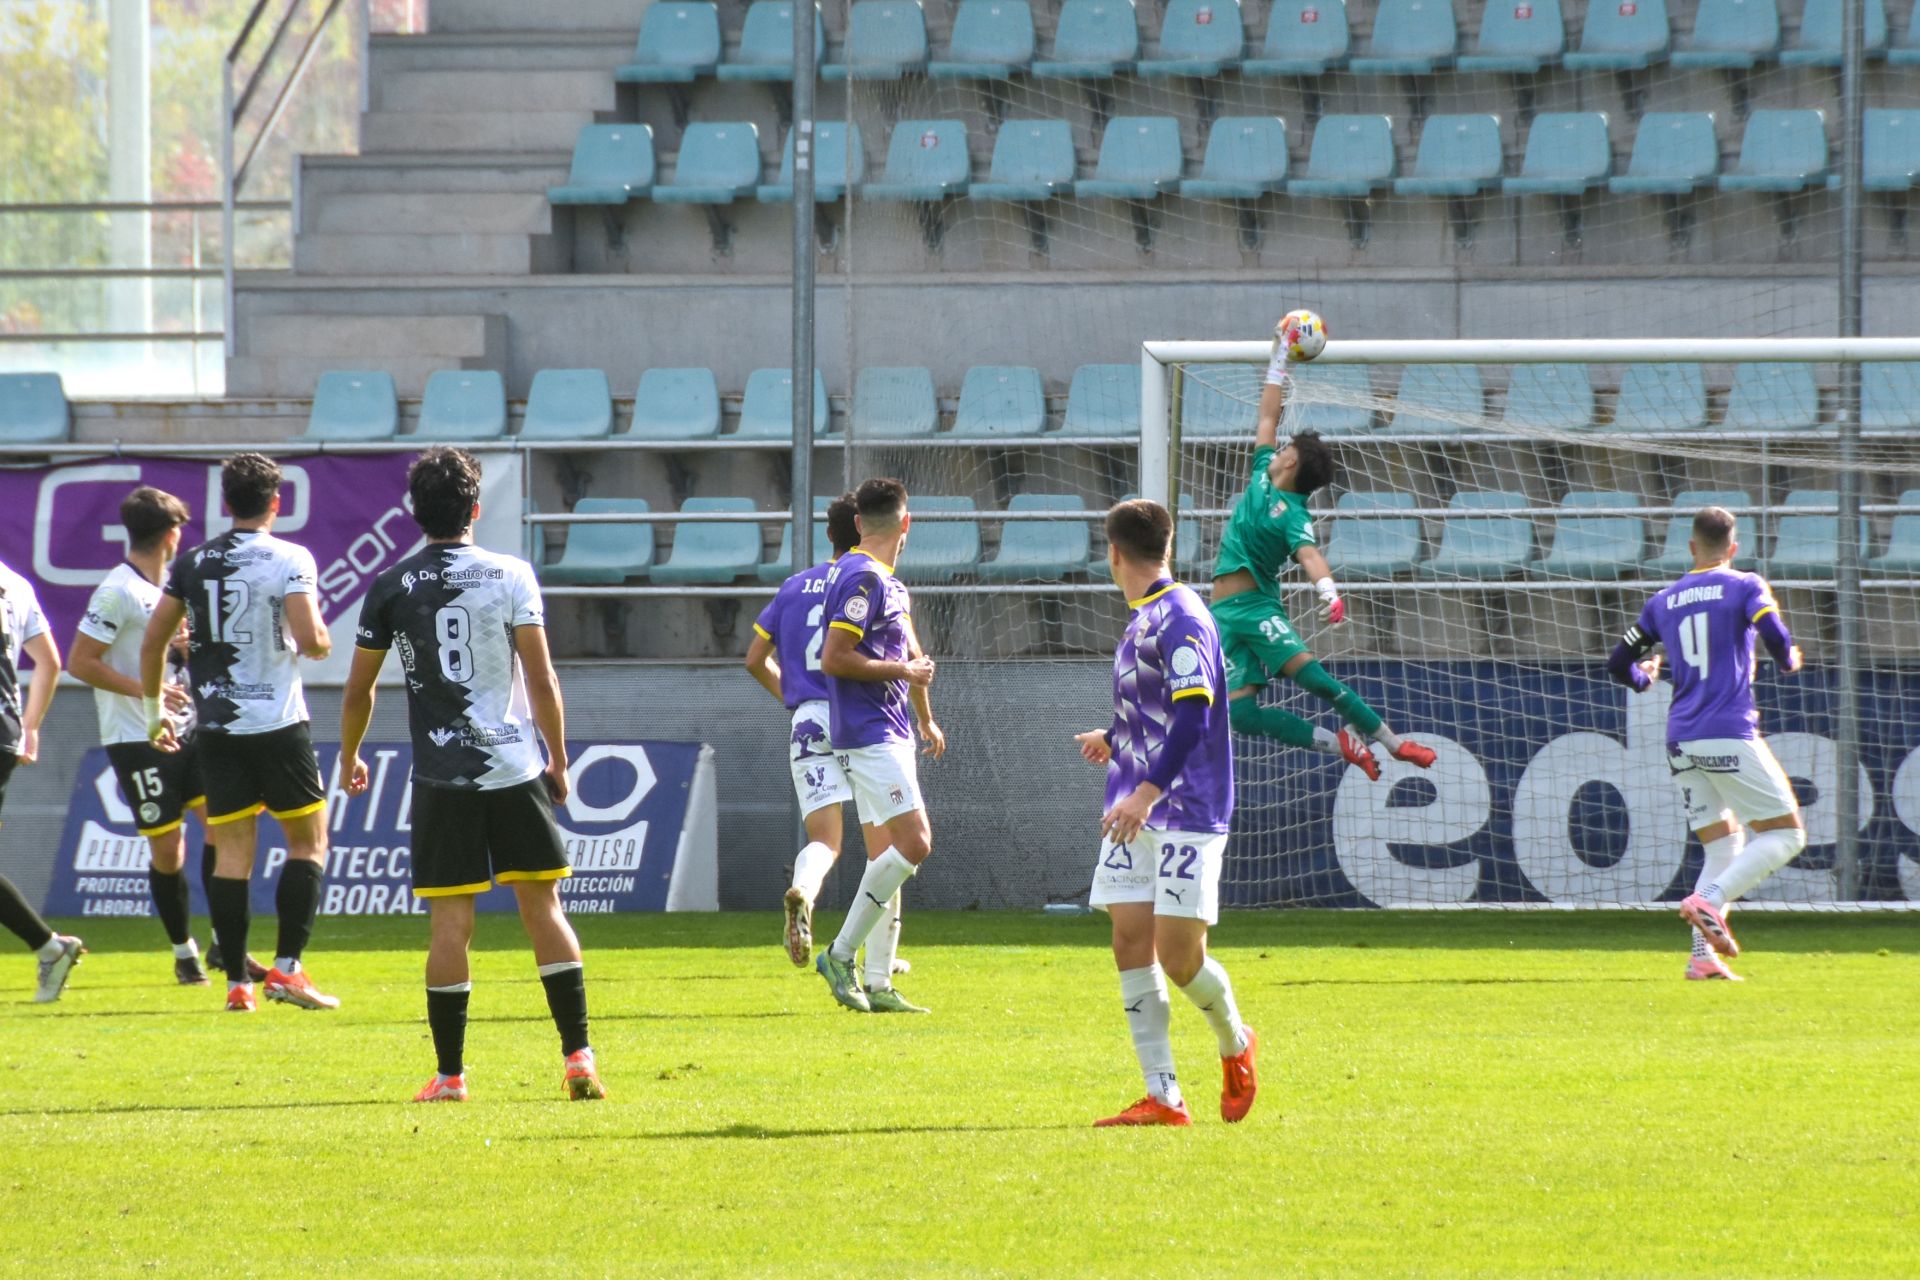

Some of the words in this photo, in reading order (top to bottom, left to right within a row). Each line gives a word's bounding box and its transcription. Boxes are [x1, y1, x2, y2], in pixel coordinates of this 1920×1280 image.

[419, 570, 438, 581] De
[441, 568, 483, 581] Castro
[485, 567, 504, 580] Gil
[203, 579, 253, 644] 12
[1667, 584, 1724, 609] V.MONGIL
[1259, 615, 1290, 643] 26
[436, 606, 475, 684] 8
[1678, 612, 1709, 681] 4
[131, 767, 163, 800] 15
[87, 838, 150, 868] PERTE
[565, 838, 636, 868] ERTESA
[1158, 842, 1198, 880] 22
[76, 876, 150, 894] PROTECCI
[83, 898, 151, 916] LABORAL
